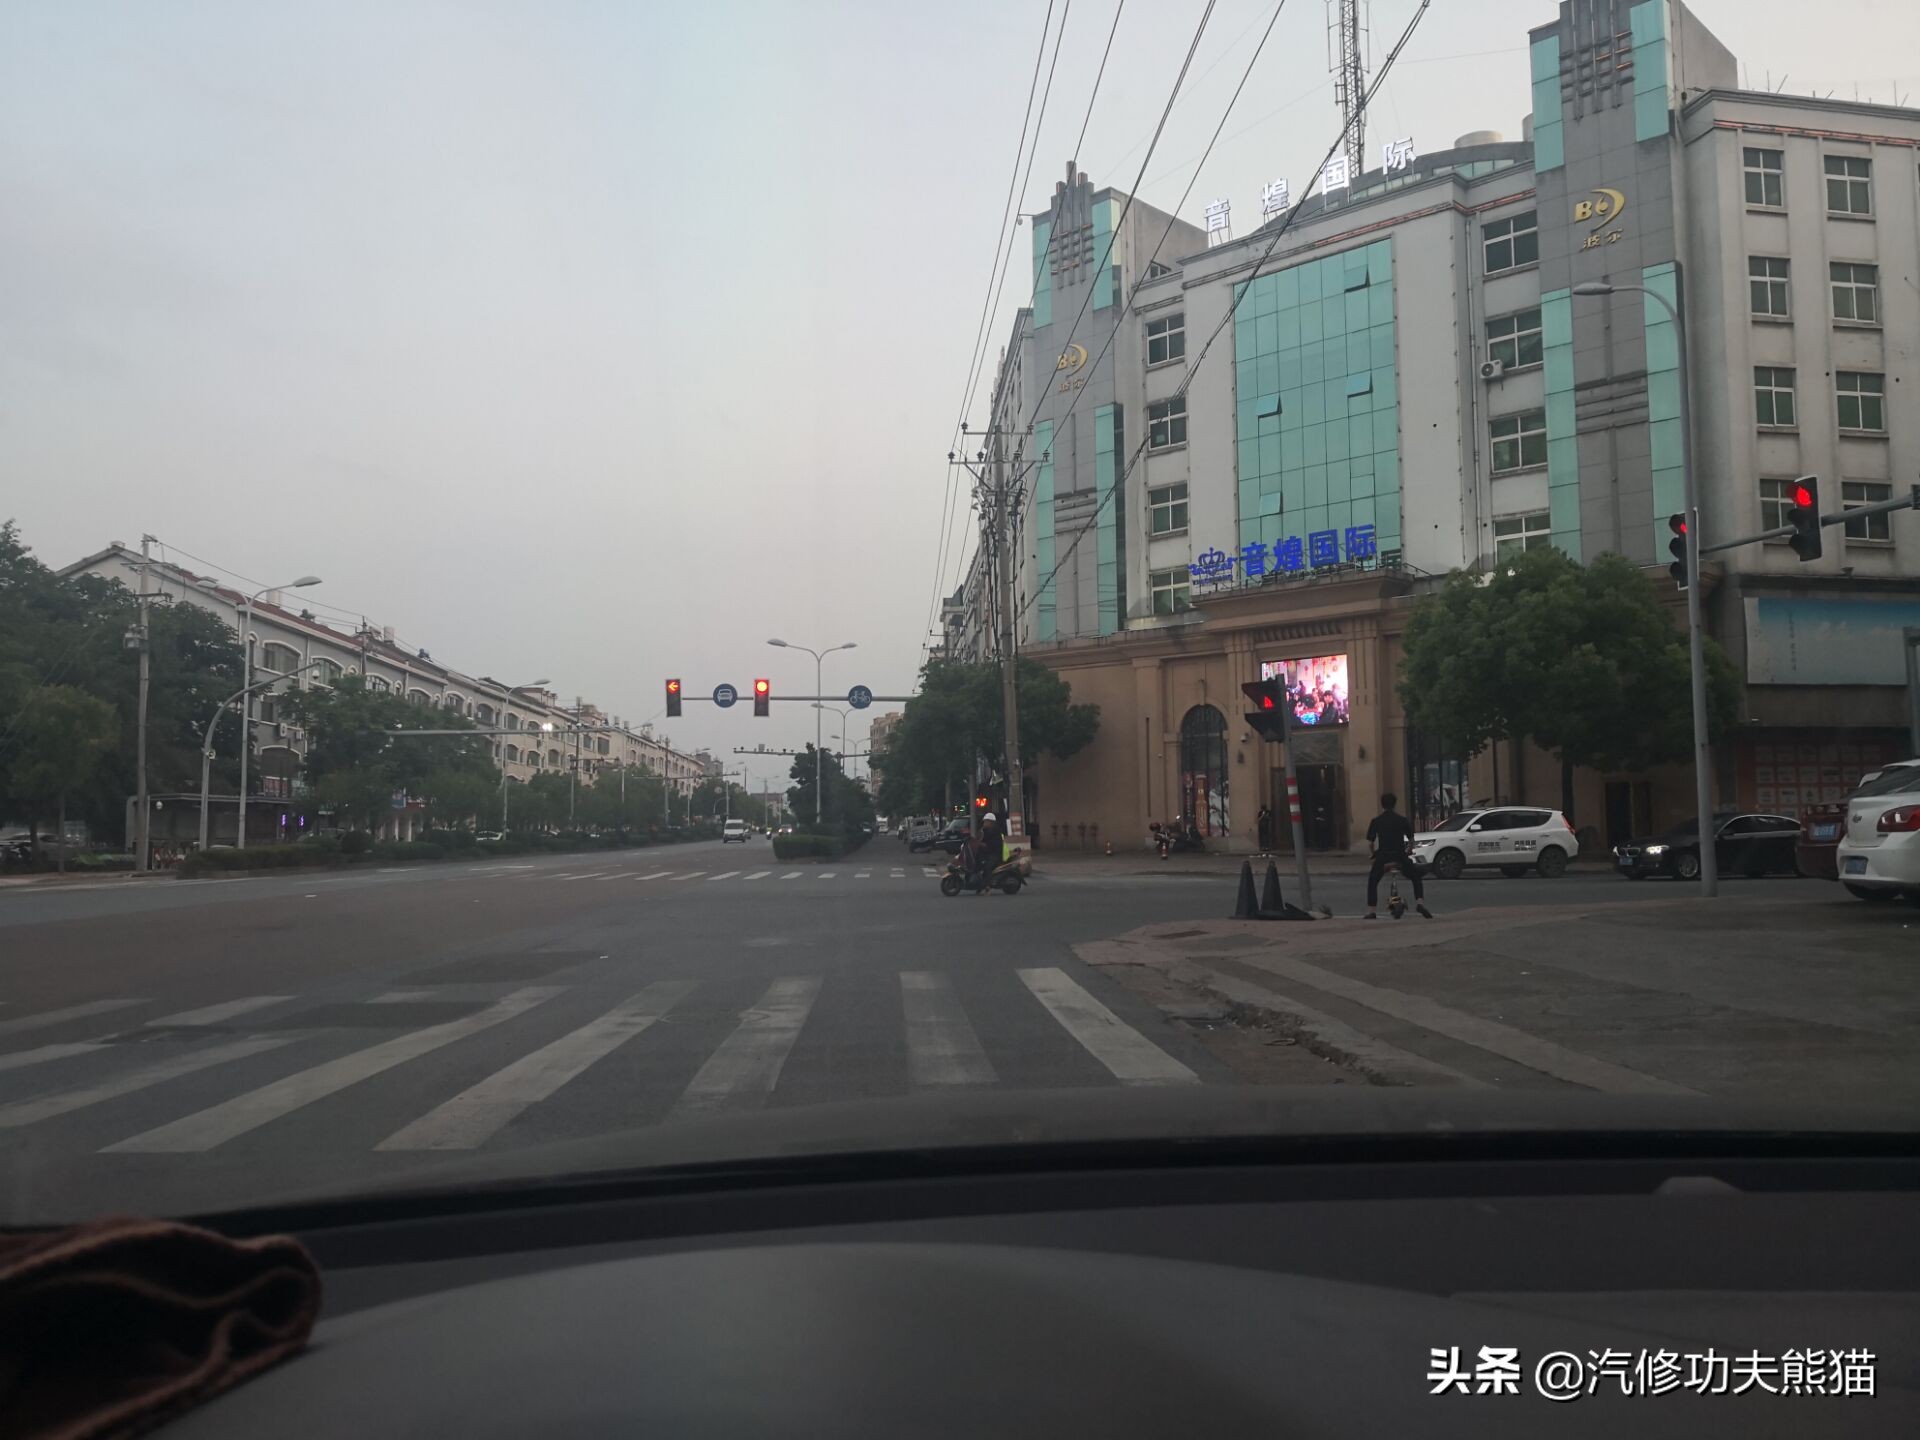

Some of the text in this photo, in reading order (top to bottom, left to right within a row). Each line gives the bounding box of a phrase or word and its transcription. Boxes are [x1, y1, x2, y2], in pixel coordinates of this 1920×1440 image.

[1205, 137, 1416, 233] 音煌国际
[1241, 524, 1377, 578] 音煌国际
